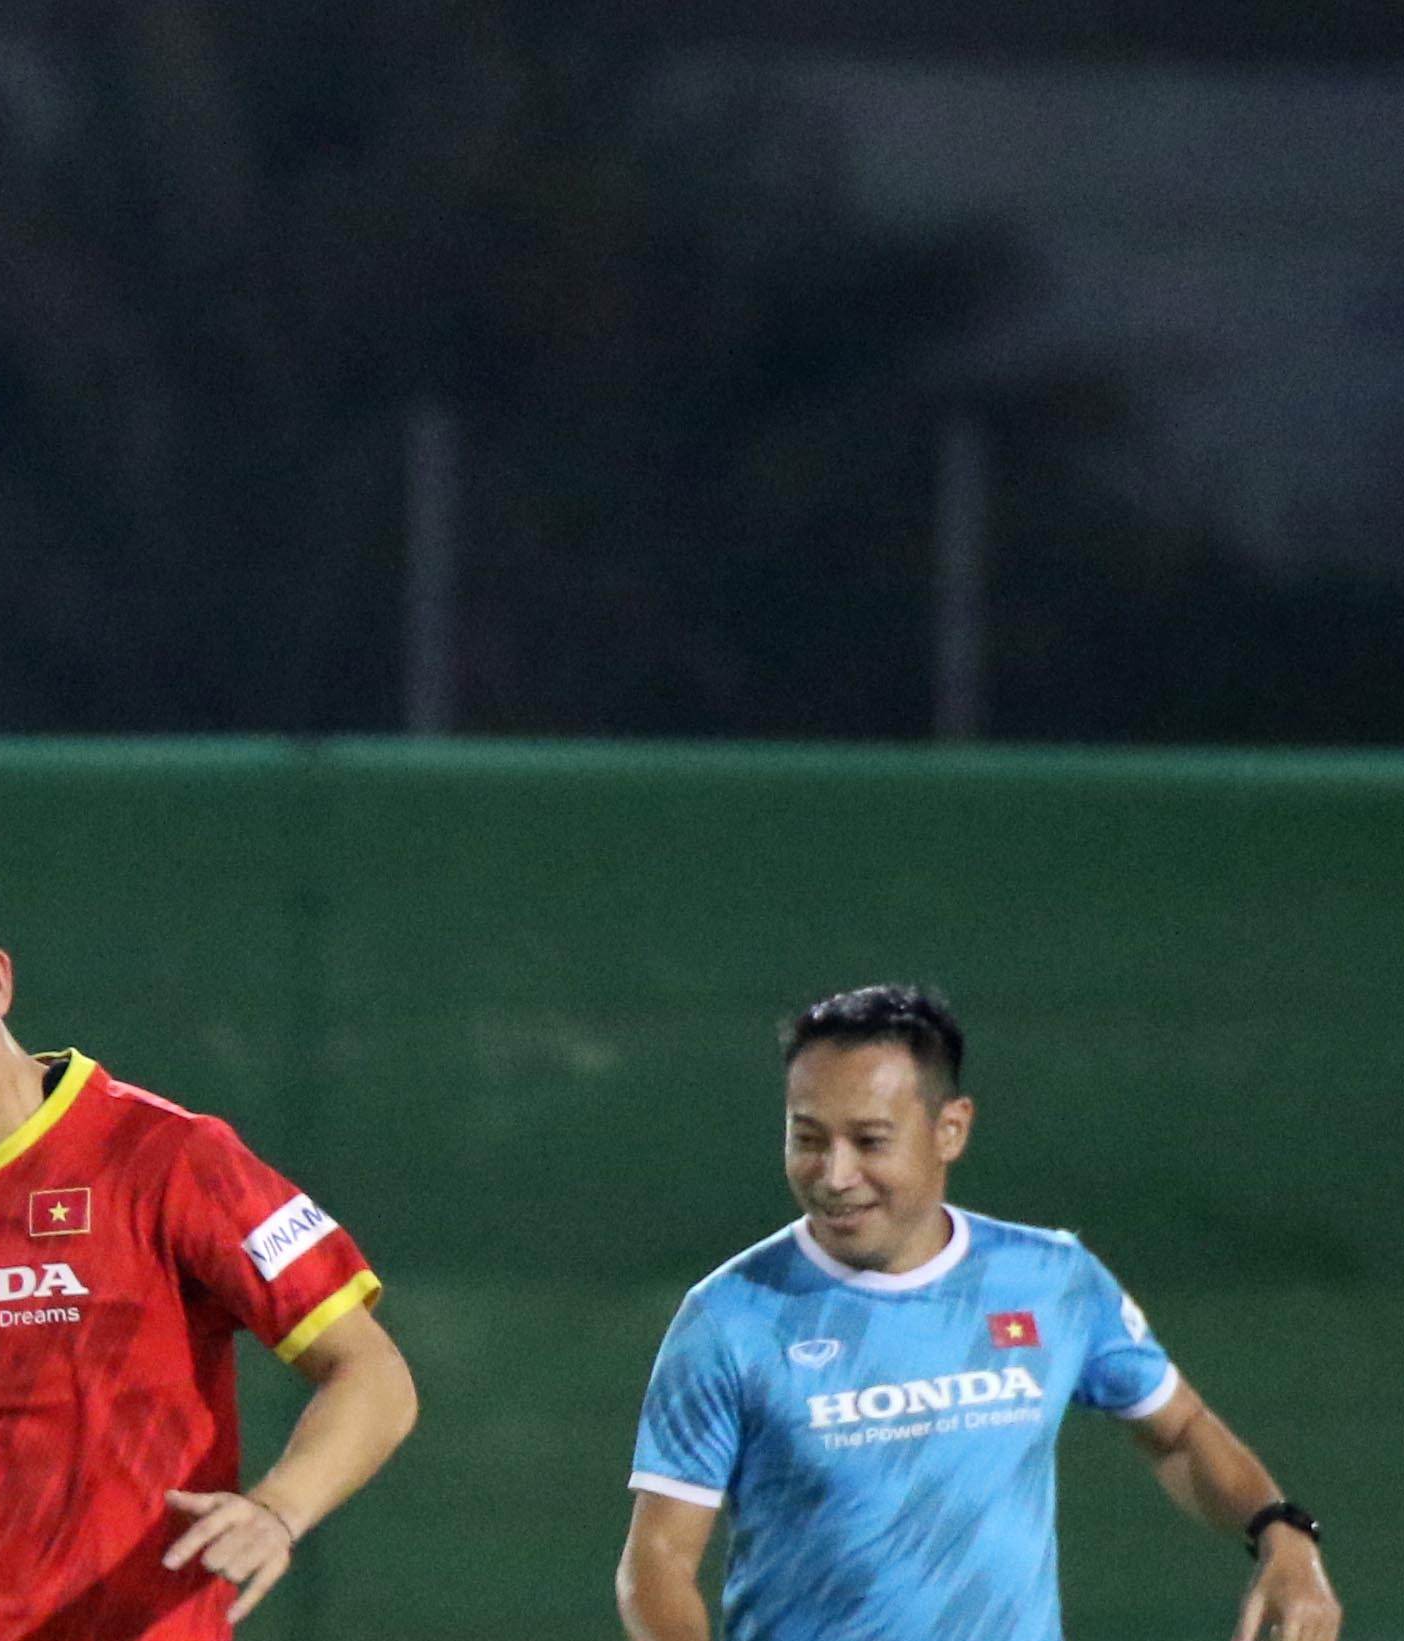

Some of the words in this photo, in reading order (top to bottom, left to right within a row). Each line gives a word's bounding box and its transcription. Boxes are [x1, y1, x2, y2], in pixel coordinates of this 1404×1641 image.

[0, 1306, 81, 1327] Dreams
[807, 1367, 1042, 1428] HONDA
[822, 1432, 863, 1449] The
[865, 1420, 932, 1443] Power
[935, 1416, 959, 1433] of
[964, 1408, 1042, 1428] Dreams
